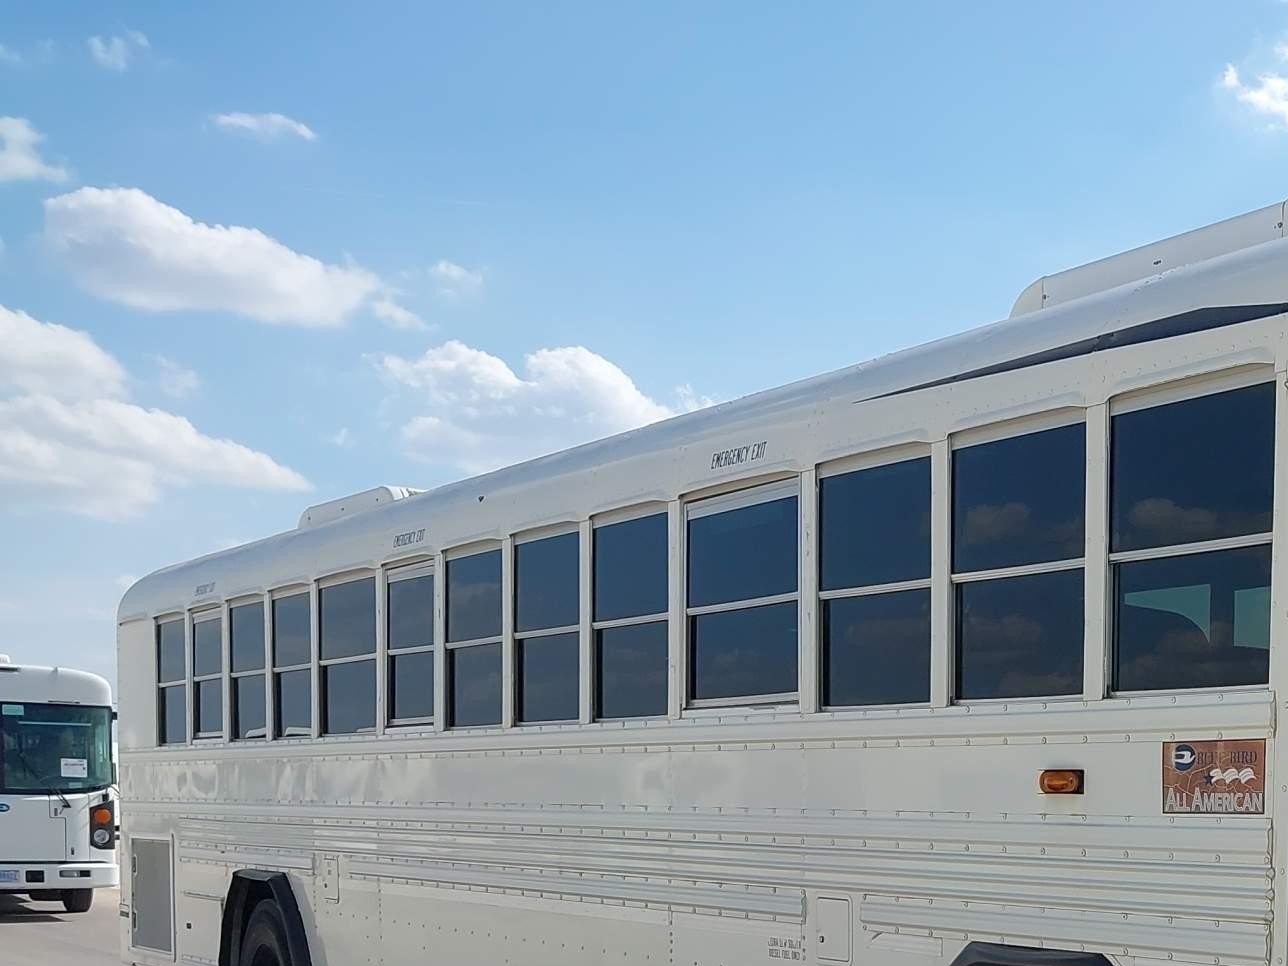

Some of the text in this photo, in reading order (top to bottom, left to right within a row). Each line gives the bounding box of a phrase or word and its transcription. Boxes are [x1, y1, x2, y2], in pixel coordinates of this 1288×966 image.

[711, 441, 767, 470] EMERGENCY EXIT
[1165, 786, 1263, 812] ALL AMERICAN
